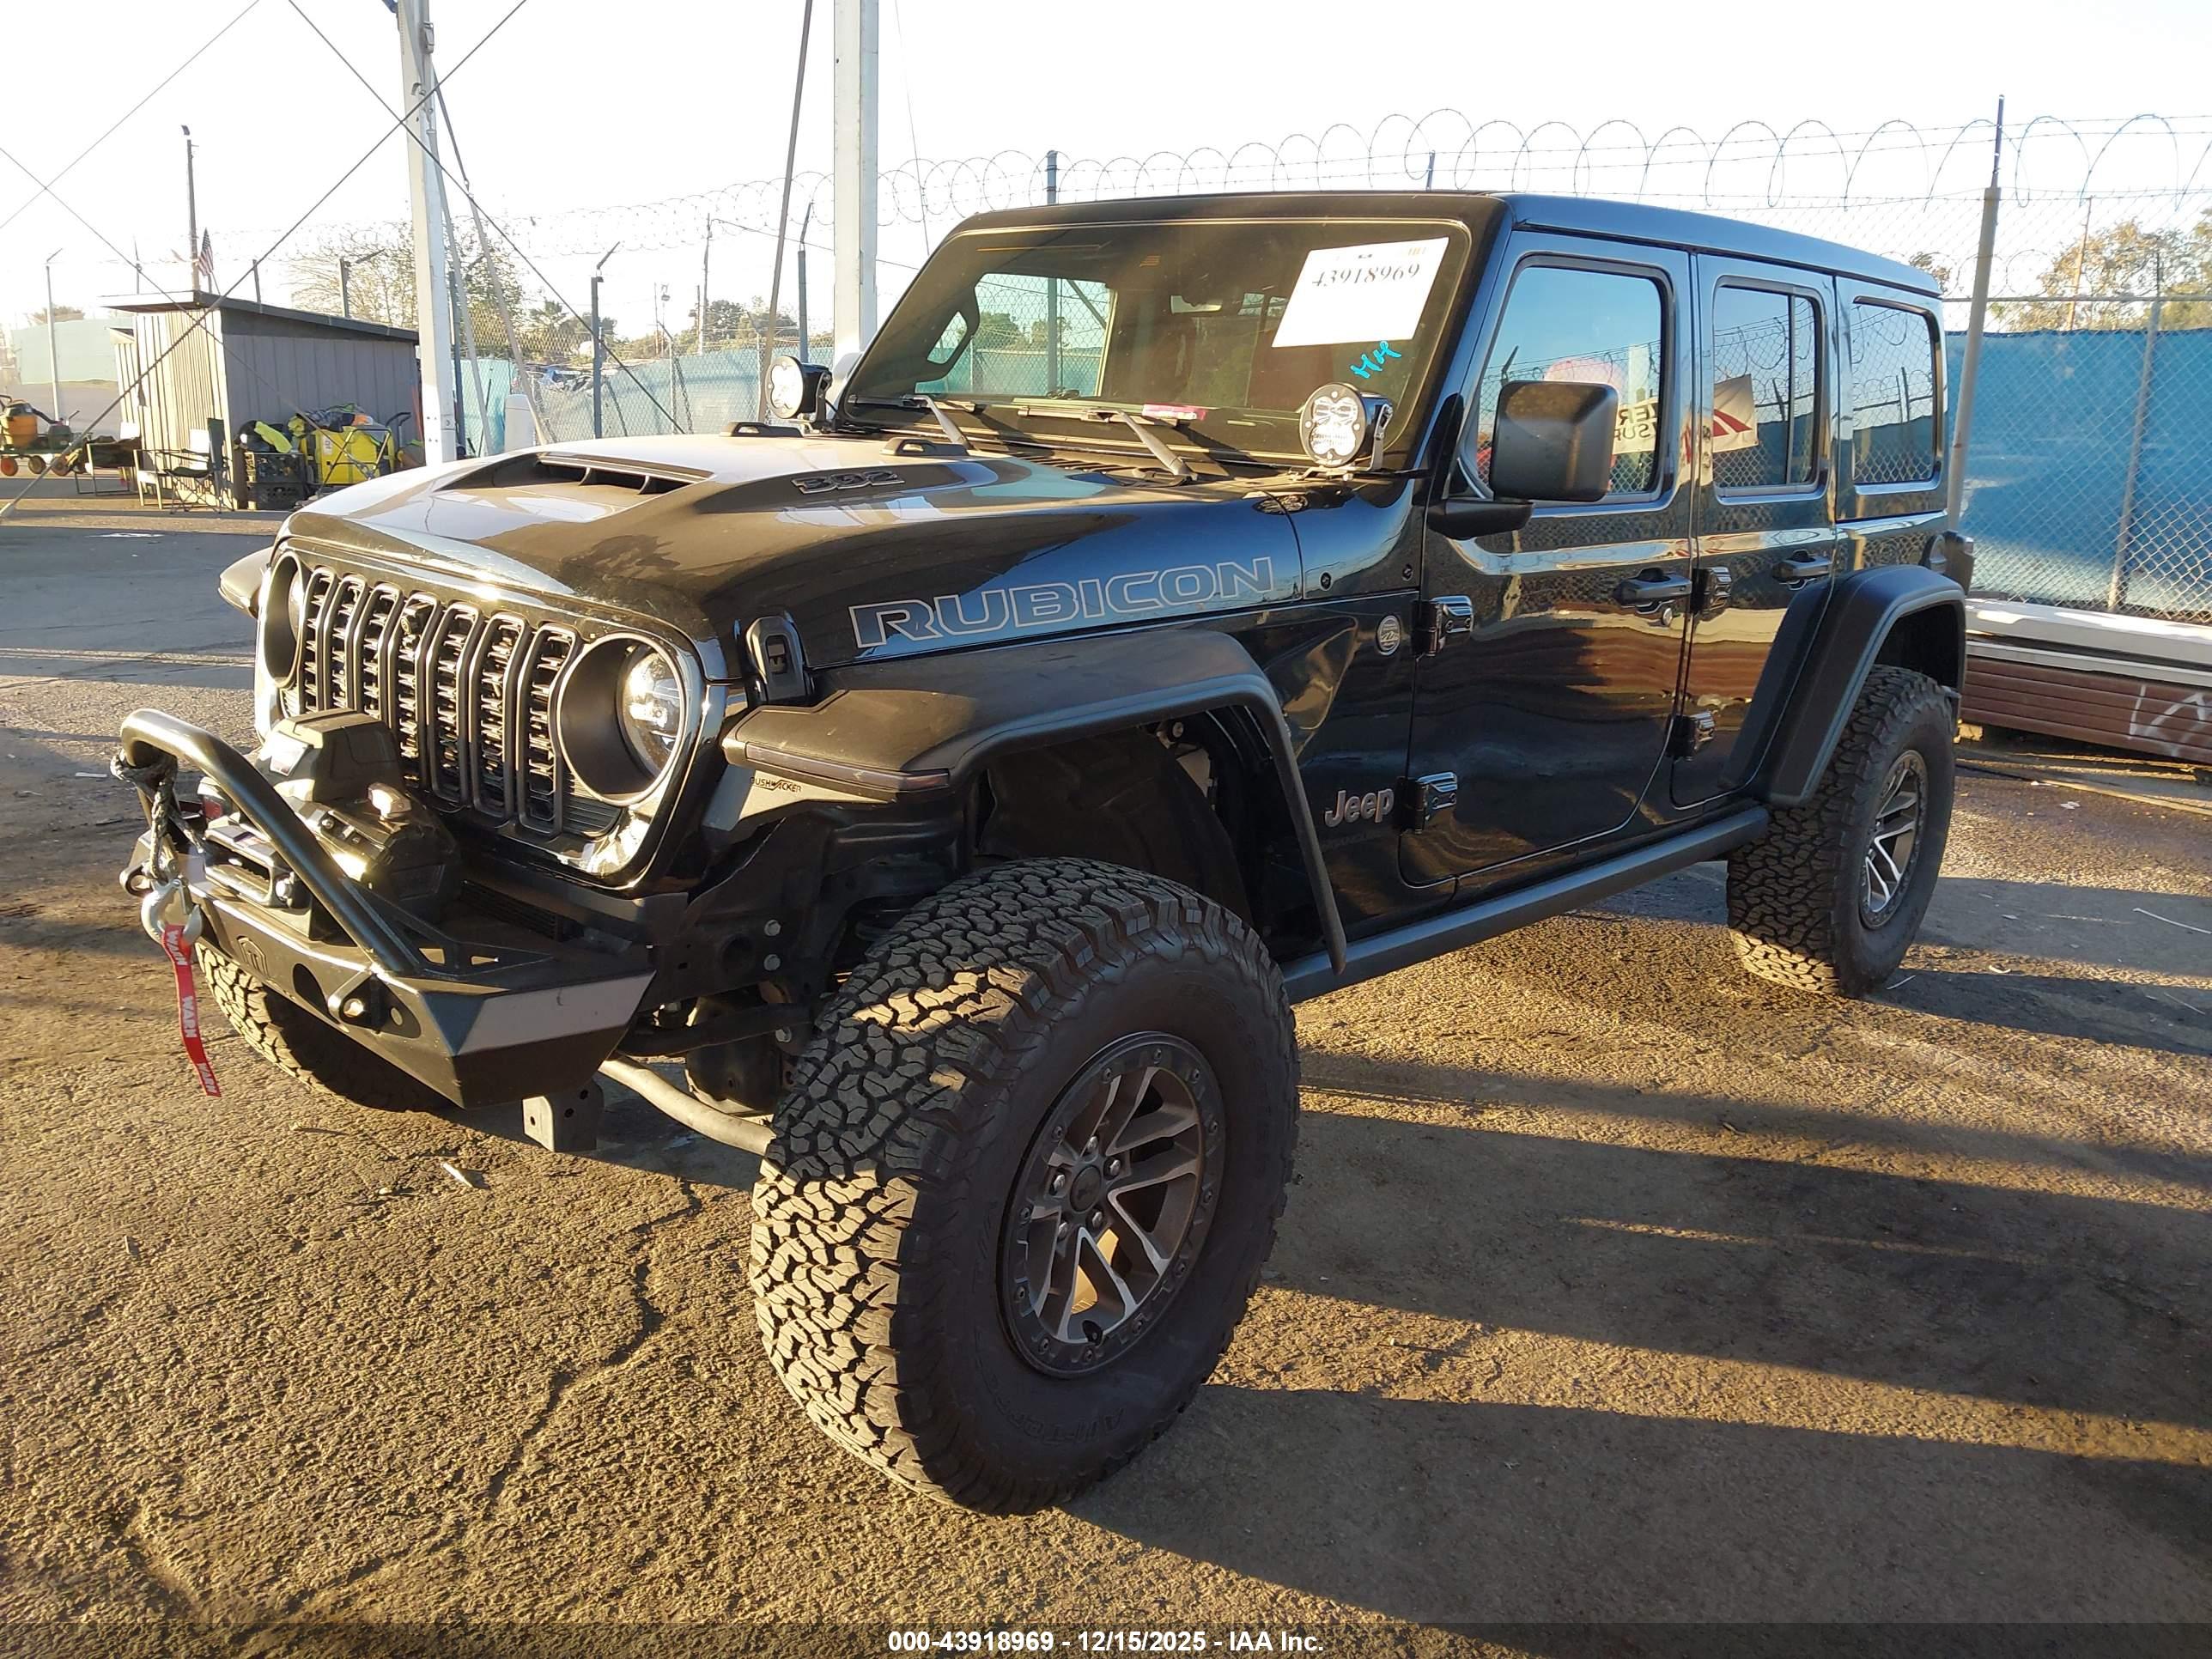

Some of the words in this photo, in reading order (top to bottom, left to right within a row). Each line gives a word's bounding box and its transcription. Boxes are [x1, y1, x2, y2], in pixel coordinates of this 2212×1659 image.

[1311, 262, 1420, 288] 43918969
[848, 556, 1275, 648] RUBICON
[1324, 788, 1395, 828] Jeep
[182, 994, 198, 1038] WARN
